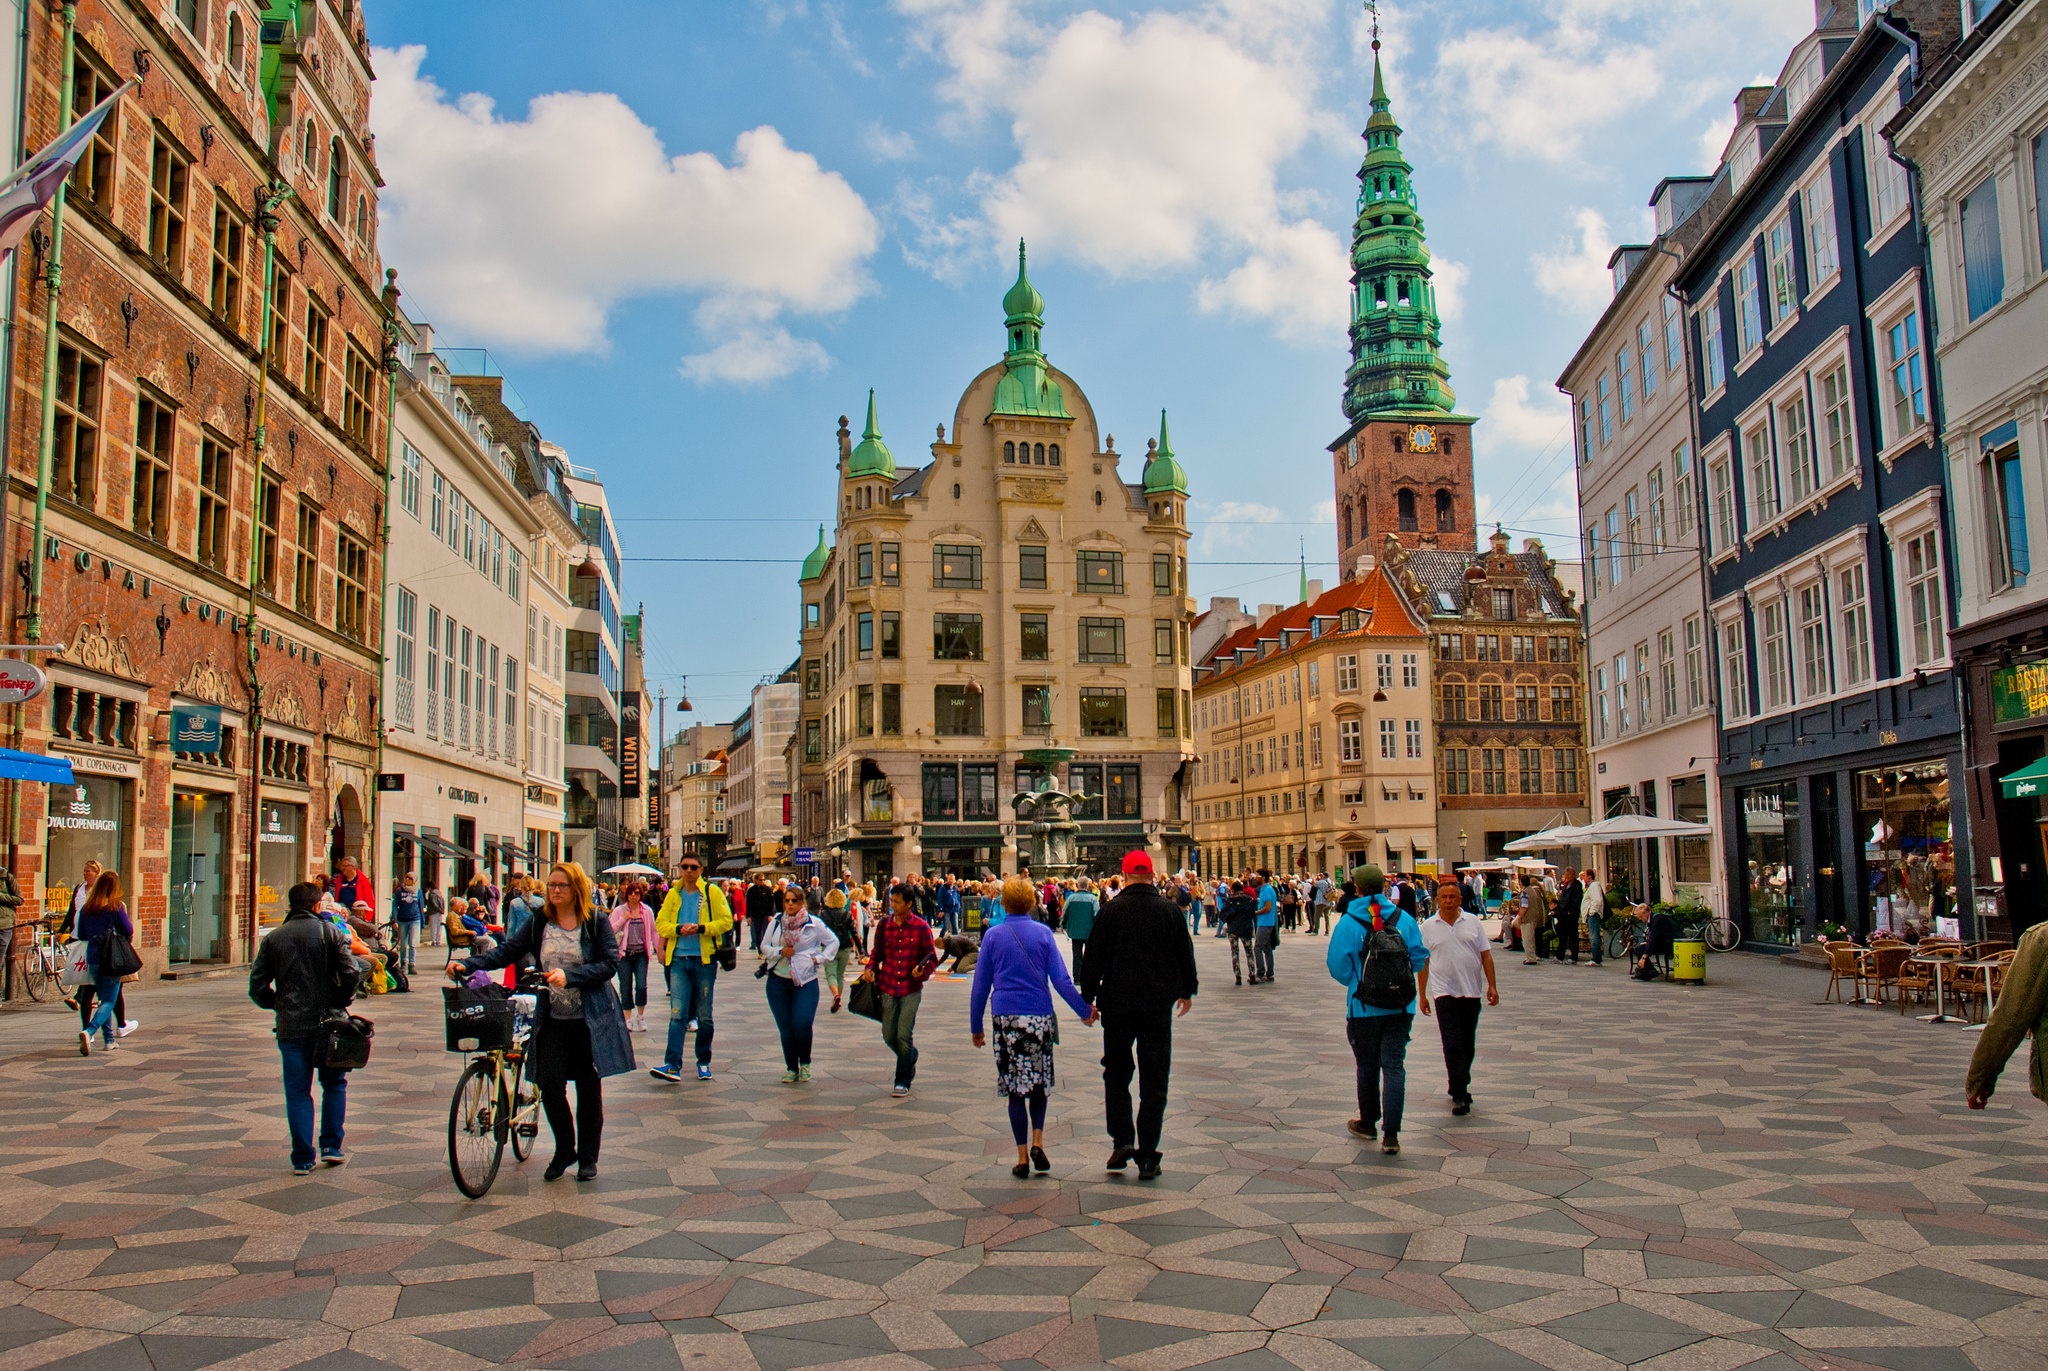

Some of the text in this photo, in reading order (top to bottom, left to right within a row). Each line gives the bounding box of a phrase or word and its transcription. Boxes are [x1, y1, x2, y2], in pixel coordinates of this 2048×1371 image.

[950, 627, 965, 635] HAY
[1025, 627, 1039, 635] HAY
[1093, 630, 1107, 638] HAY
[86, 758, 128, 773] COPENHAGEN
[624, 736, 637, 784] ILLUM
[650, 796, 659, 825] ILLUM
[67, 817, 118, 831] COPENHAGEN
